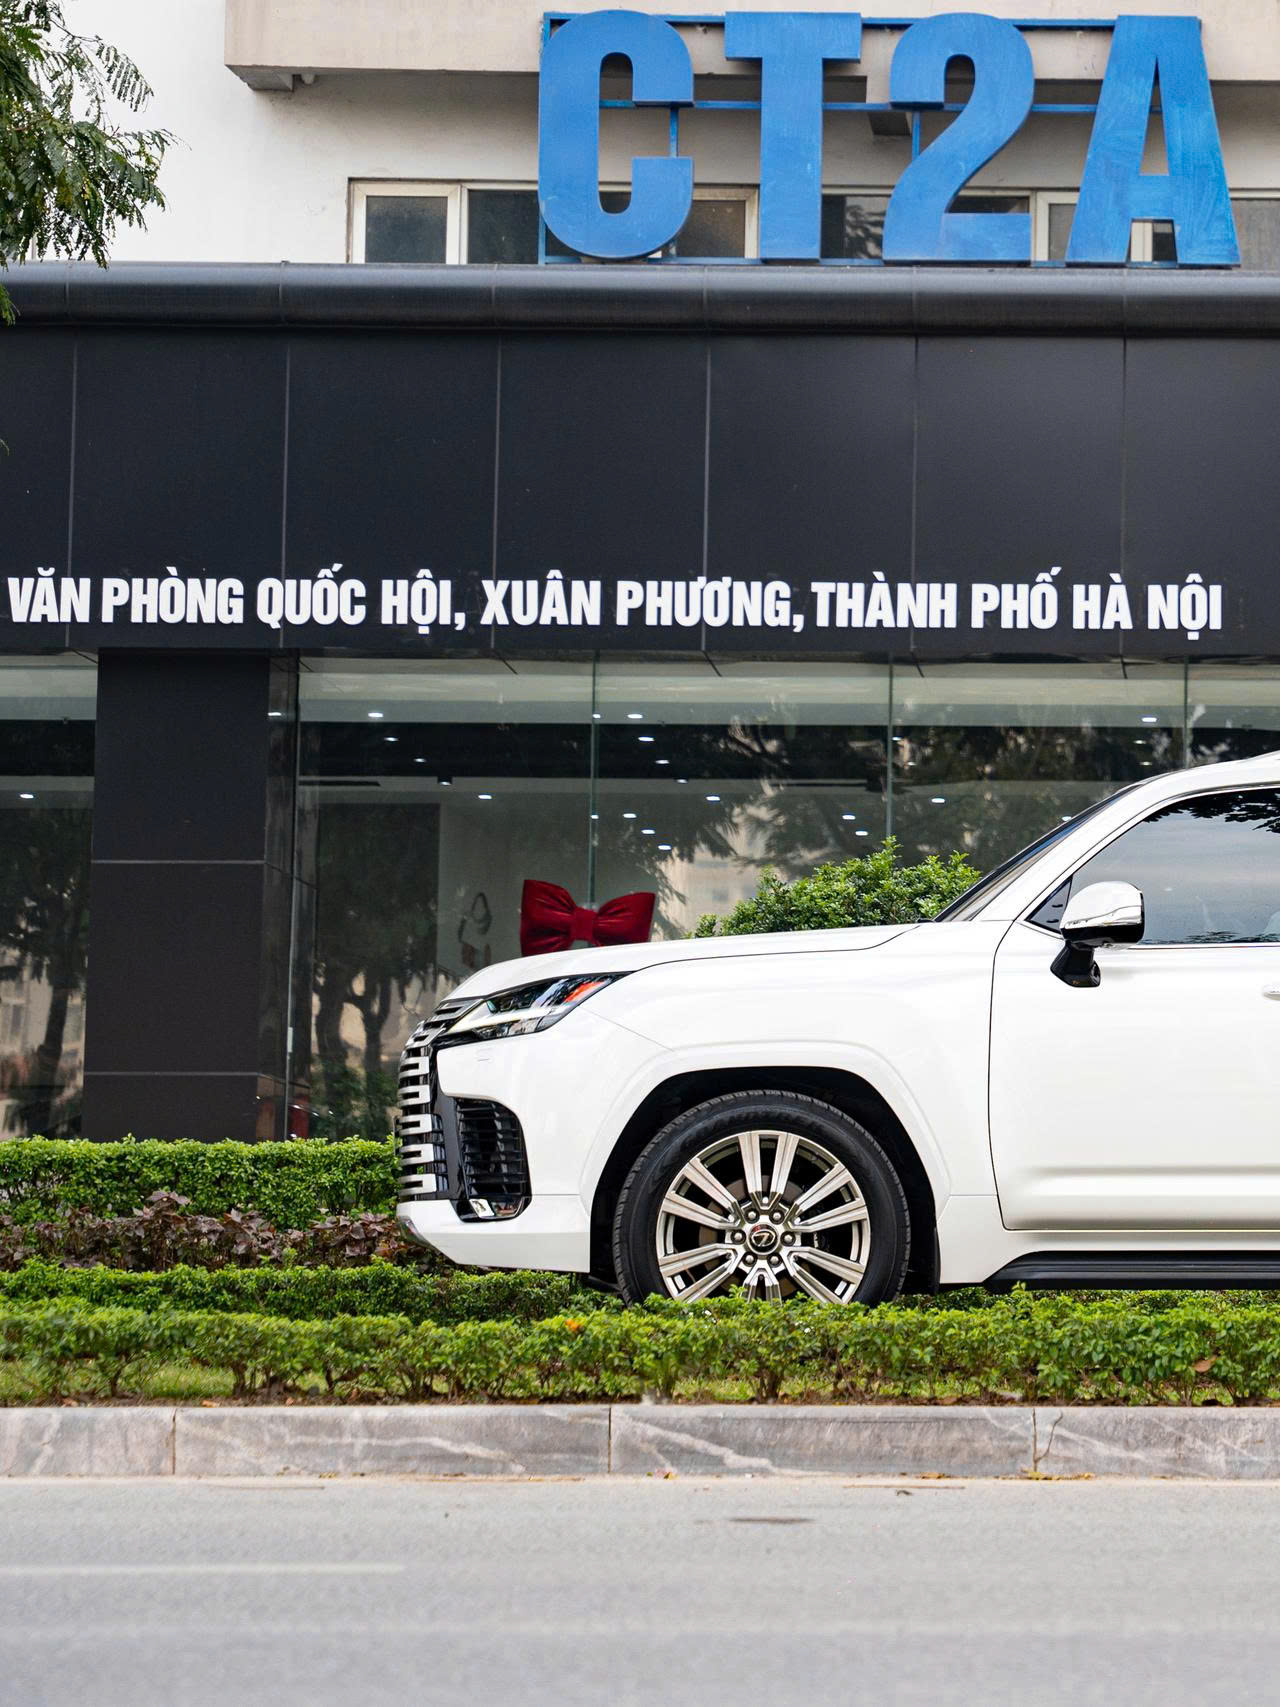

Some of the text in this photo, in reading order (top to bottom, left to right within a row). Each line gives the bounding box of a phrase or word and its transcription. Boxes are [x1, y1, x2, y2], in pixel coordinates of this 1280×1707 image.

[537, 9, 1241, 268] CT2A
[7, 566, 91, 623] VĂN
[101, 566, 244, 624] PHÒNG
[256, 563, 367, 629] QUỐC
[381, 568, 466, 635] HỘI,
[479, 569, 602, 626] XUÂN
[810, 571, 958, 629] THÀNH
[970, 566, 1062, 630] PHỐ
[1072, 572, 1134, 630] HÀ
[1147, 573, 1222, 641] NỘI
